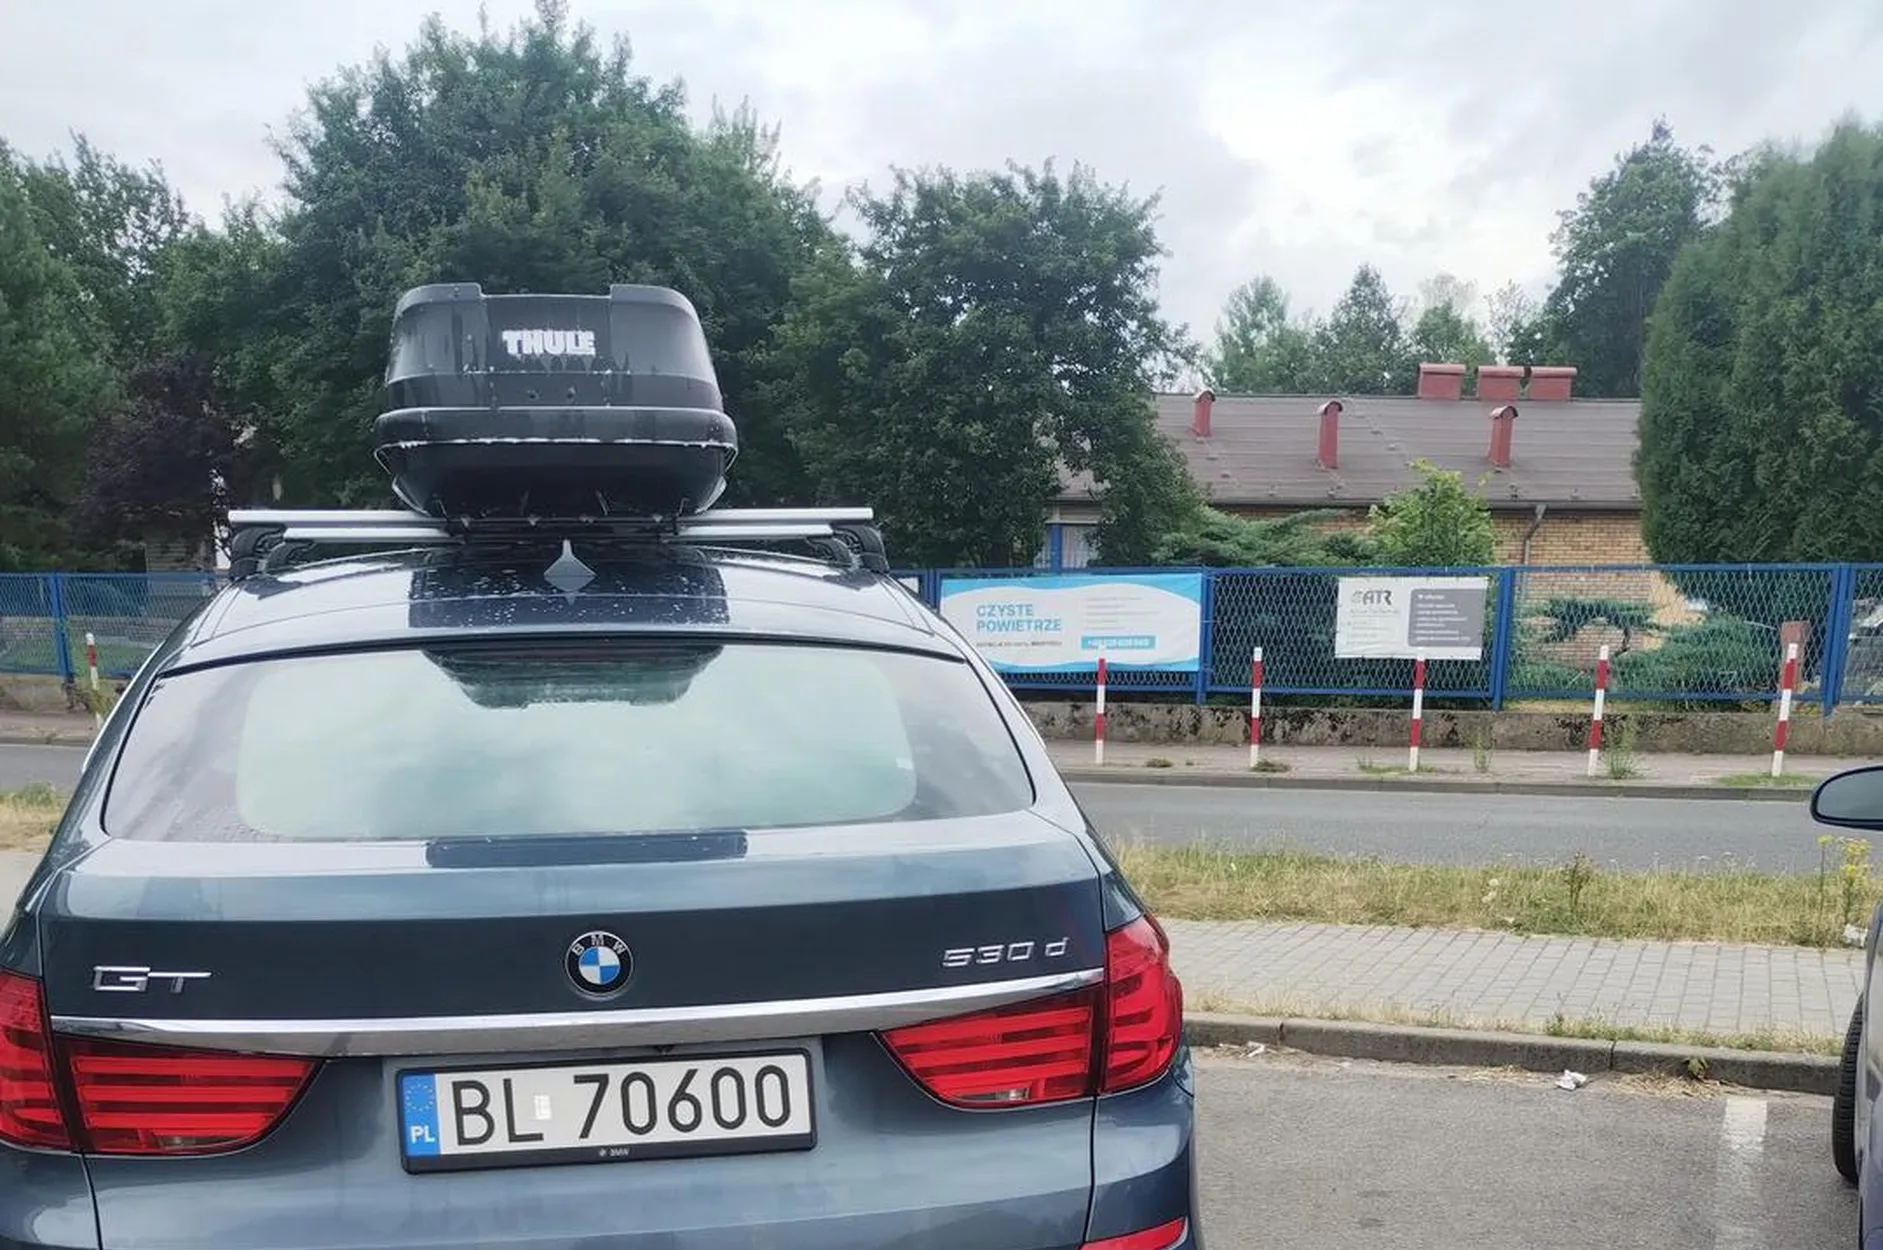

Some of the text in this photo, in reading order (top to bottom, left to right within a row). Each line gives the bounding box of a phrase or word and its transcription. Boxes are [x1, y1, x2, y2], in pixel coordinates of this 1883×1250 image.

[502, 329, 596, 356] THULE
[976, 604, 1033, 617] CZYSTE
[976, 619, 1062, 632] POWIETRZE
[571, 934, 628, 956] BMW
[942, 937, 1069, 967] 530 d
[93, 966, 212, 993] GT
[452, 1064, 792, 1147] BL 70600
[411, 1125, 436, 1144] PL
